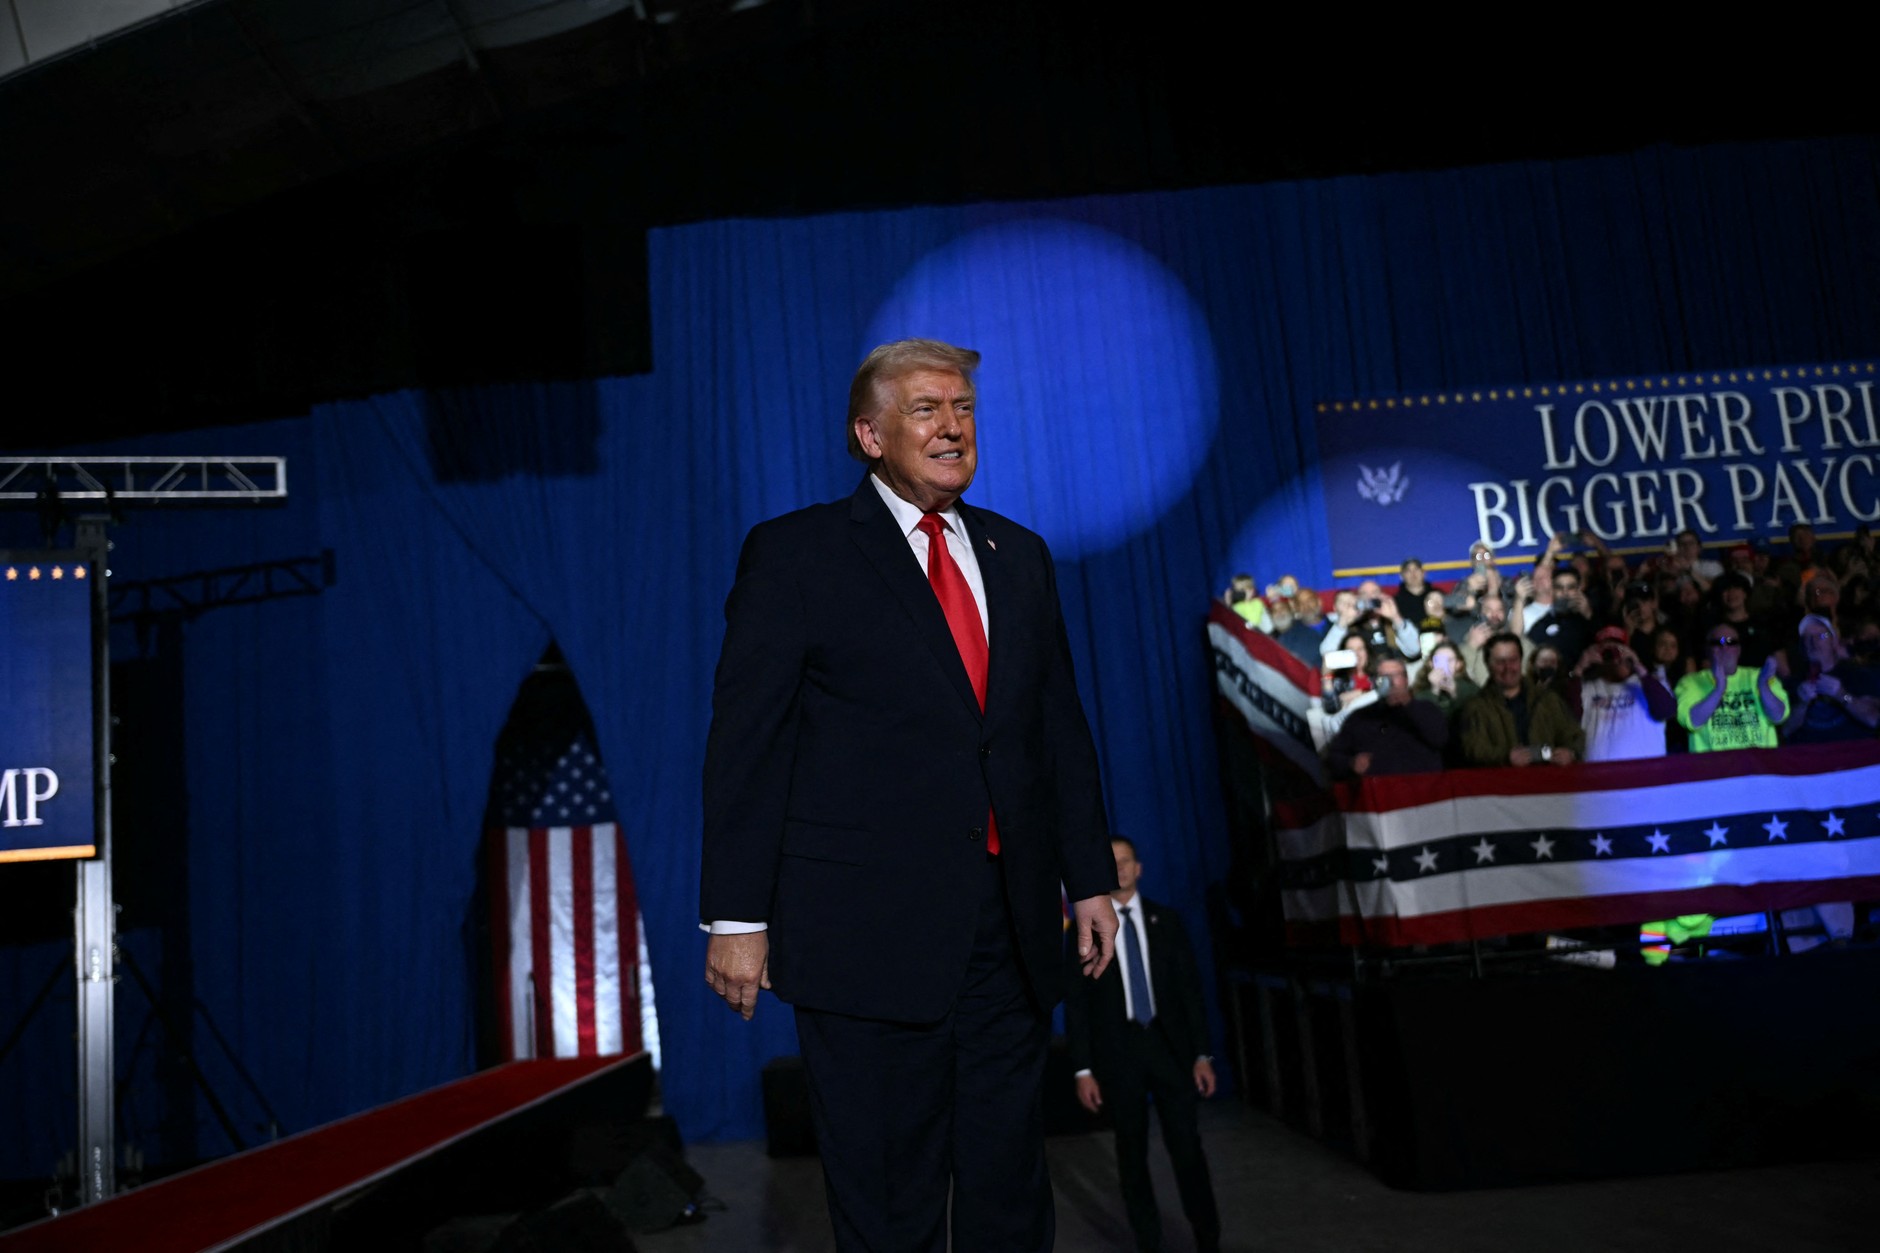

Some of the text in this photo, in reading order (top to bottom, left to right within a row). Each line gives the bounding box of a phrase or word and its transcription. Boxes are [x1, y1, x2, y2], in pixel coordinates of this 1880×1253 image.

[1534, 380, 1880, 470] LOWER PRI
[1468, 453, 1880, 549] BIGGER PAYC
